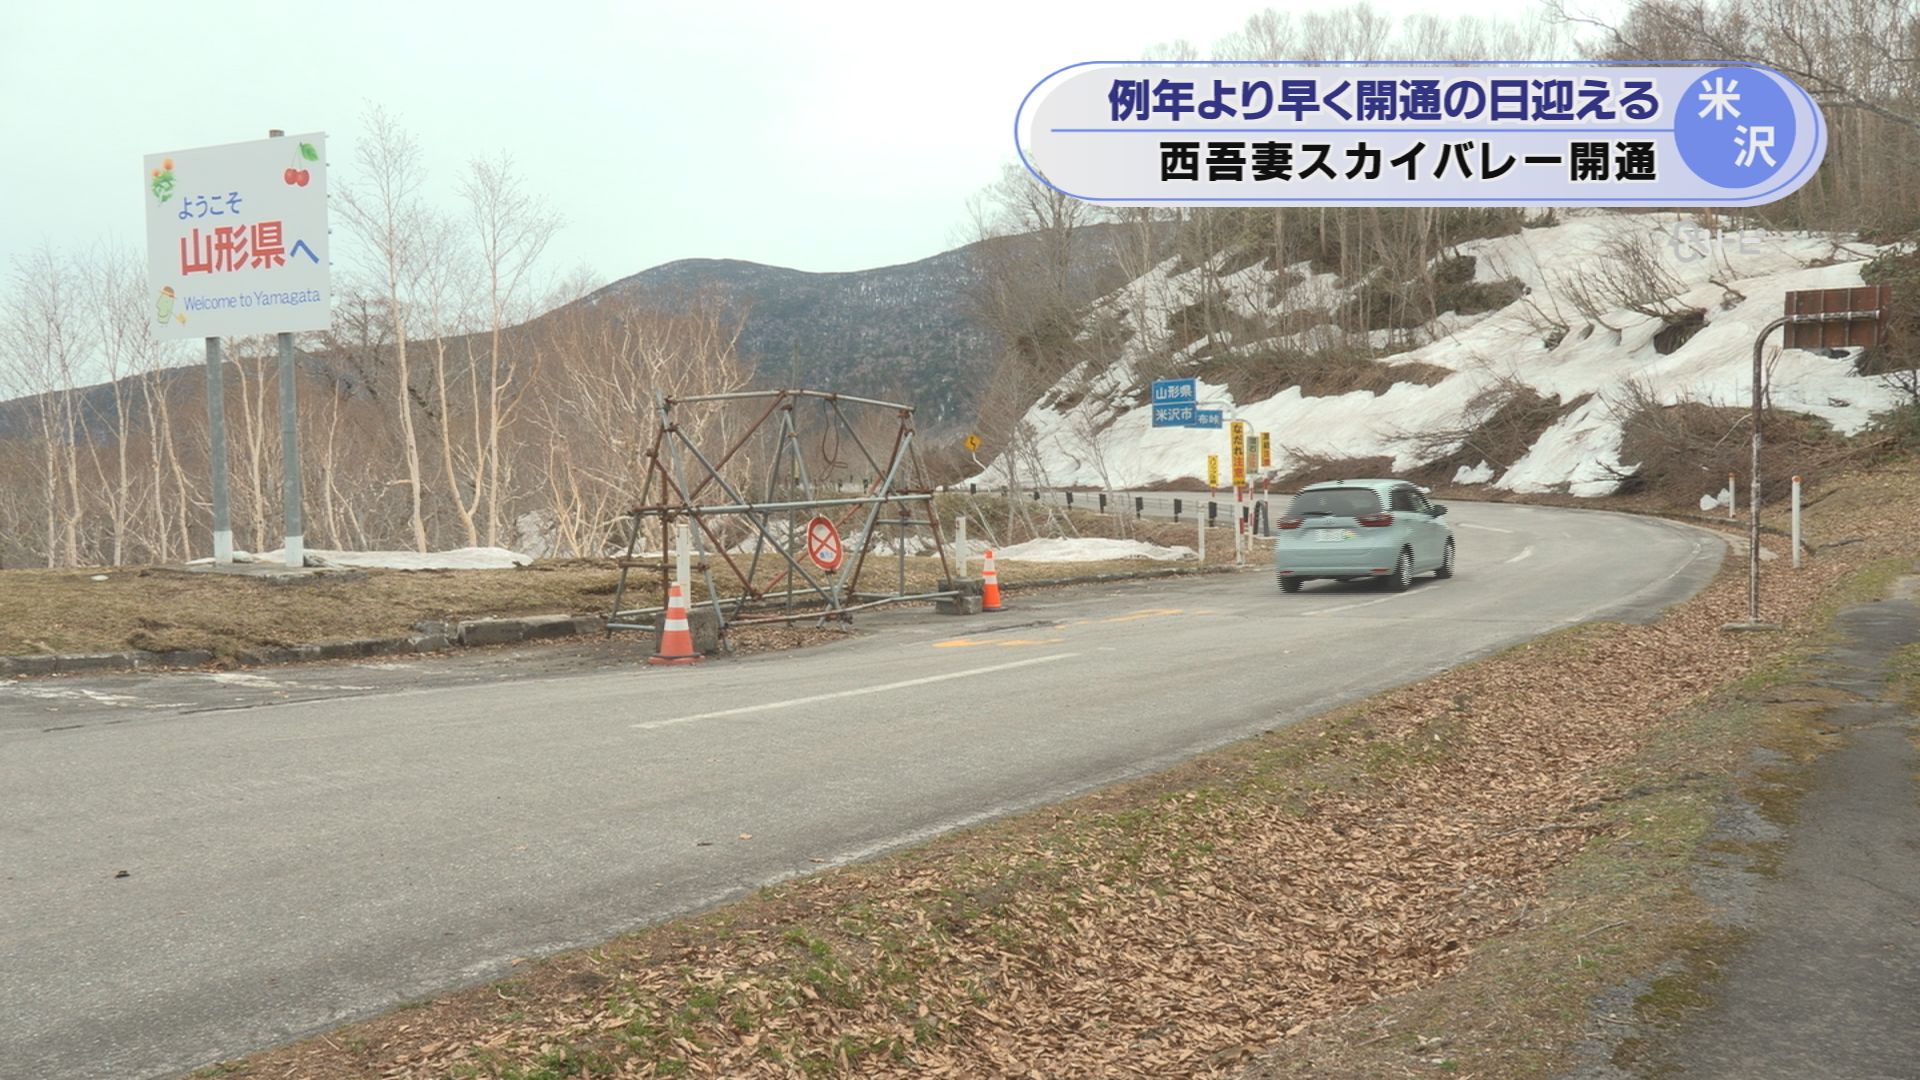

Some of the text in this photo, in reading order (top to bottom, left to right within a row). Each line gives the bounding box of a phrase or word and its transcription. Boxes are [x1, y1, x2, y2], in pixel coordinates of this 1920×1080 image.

[178, 191, 243, 220] ようこそ
[179, 221, 320, 276] 山形県へ
[183, 289, 321, 311] Welcome to Yamagata
[1155, 384, 1193, 400] 山形県
[1155, 407, 1193, 422] 米沢市
